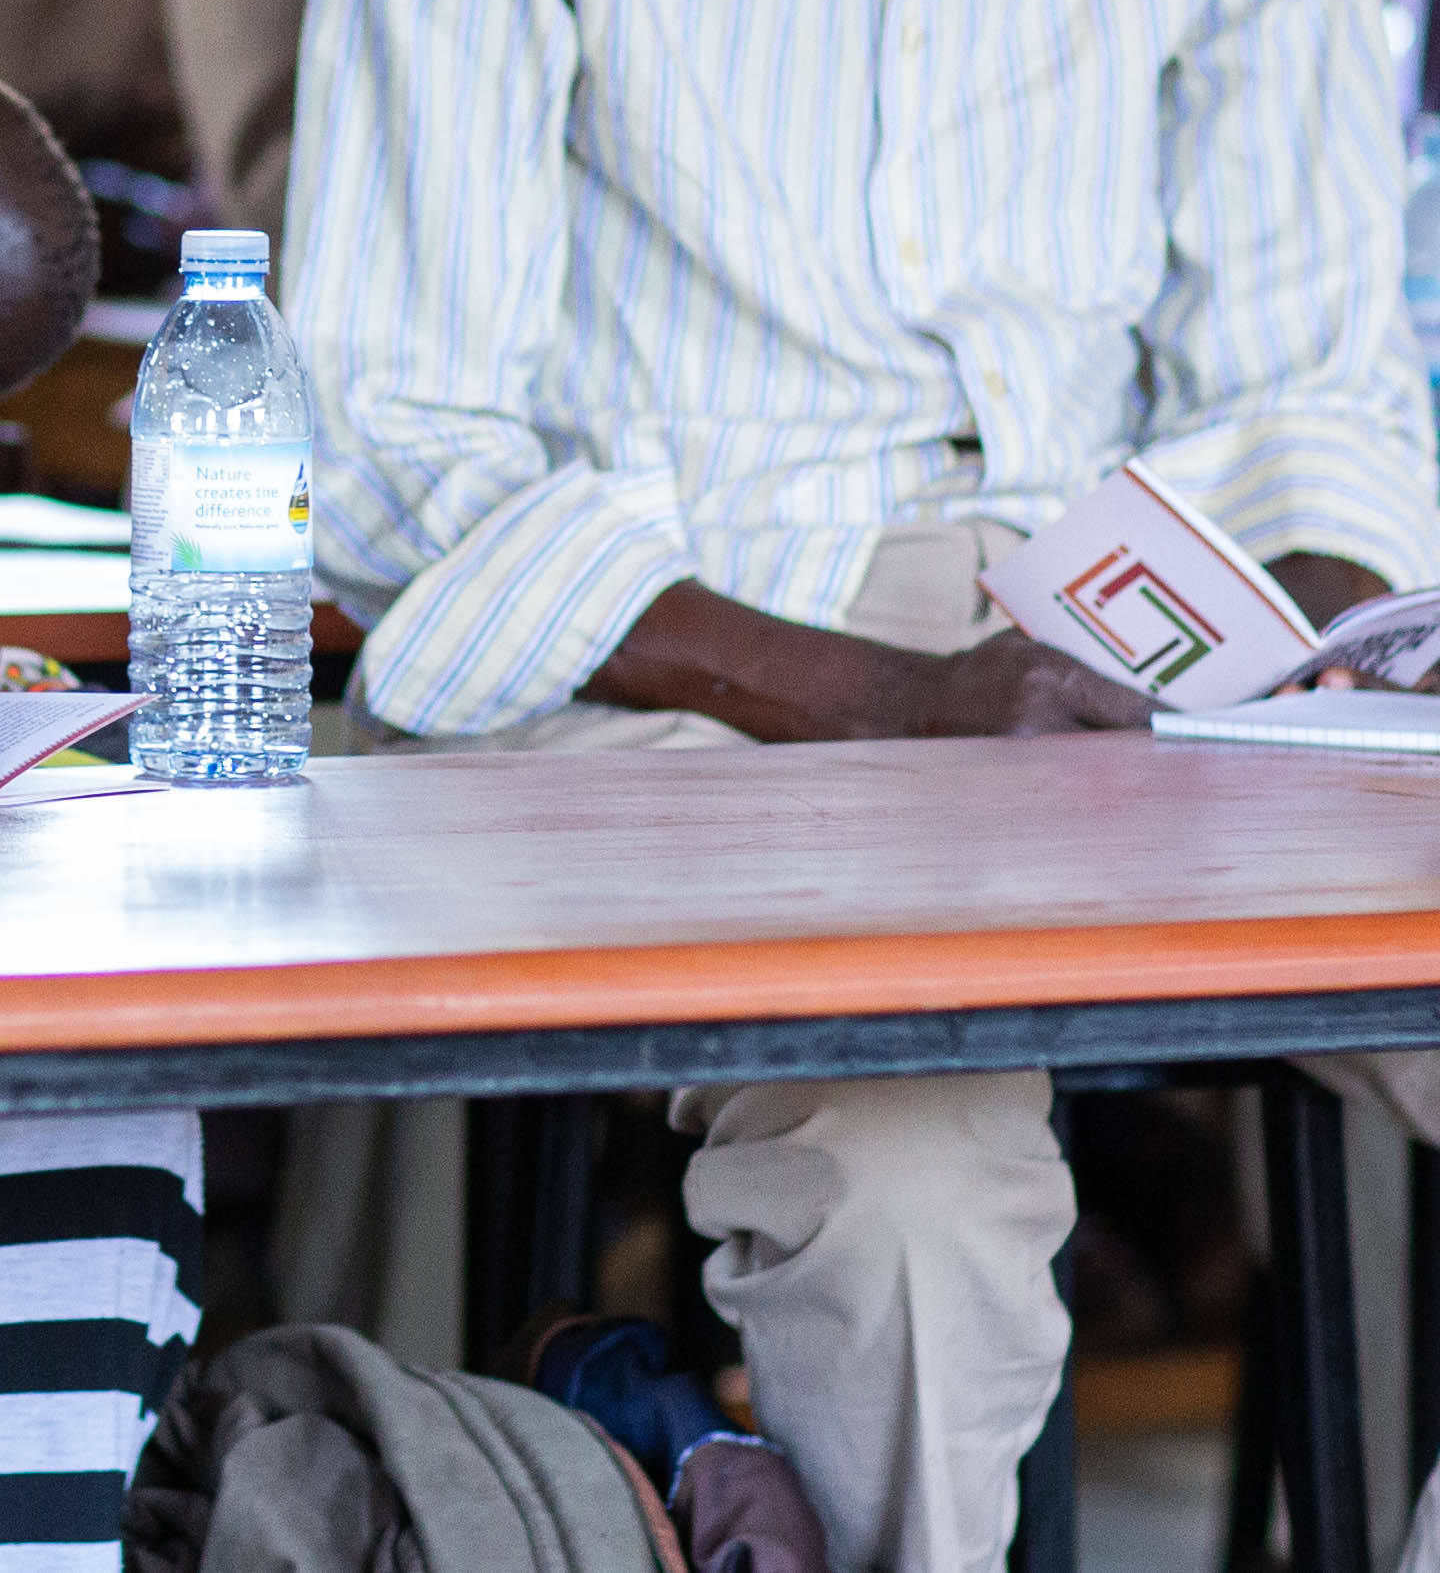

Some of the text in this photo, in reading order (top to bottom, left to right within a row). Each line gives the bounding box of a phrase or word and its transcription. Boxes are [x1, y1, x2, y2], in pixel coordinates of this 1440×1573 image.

[196, 466, 252, 481] Nature
[195, 484, 279, 499] creates the
